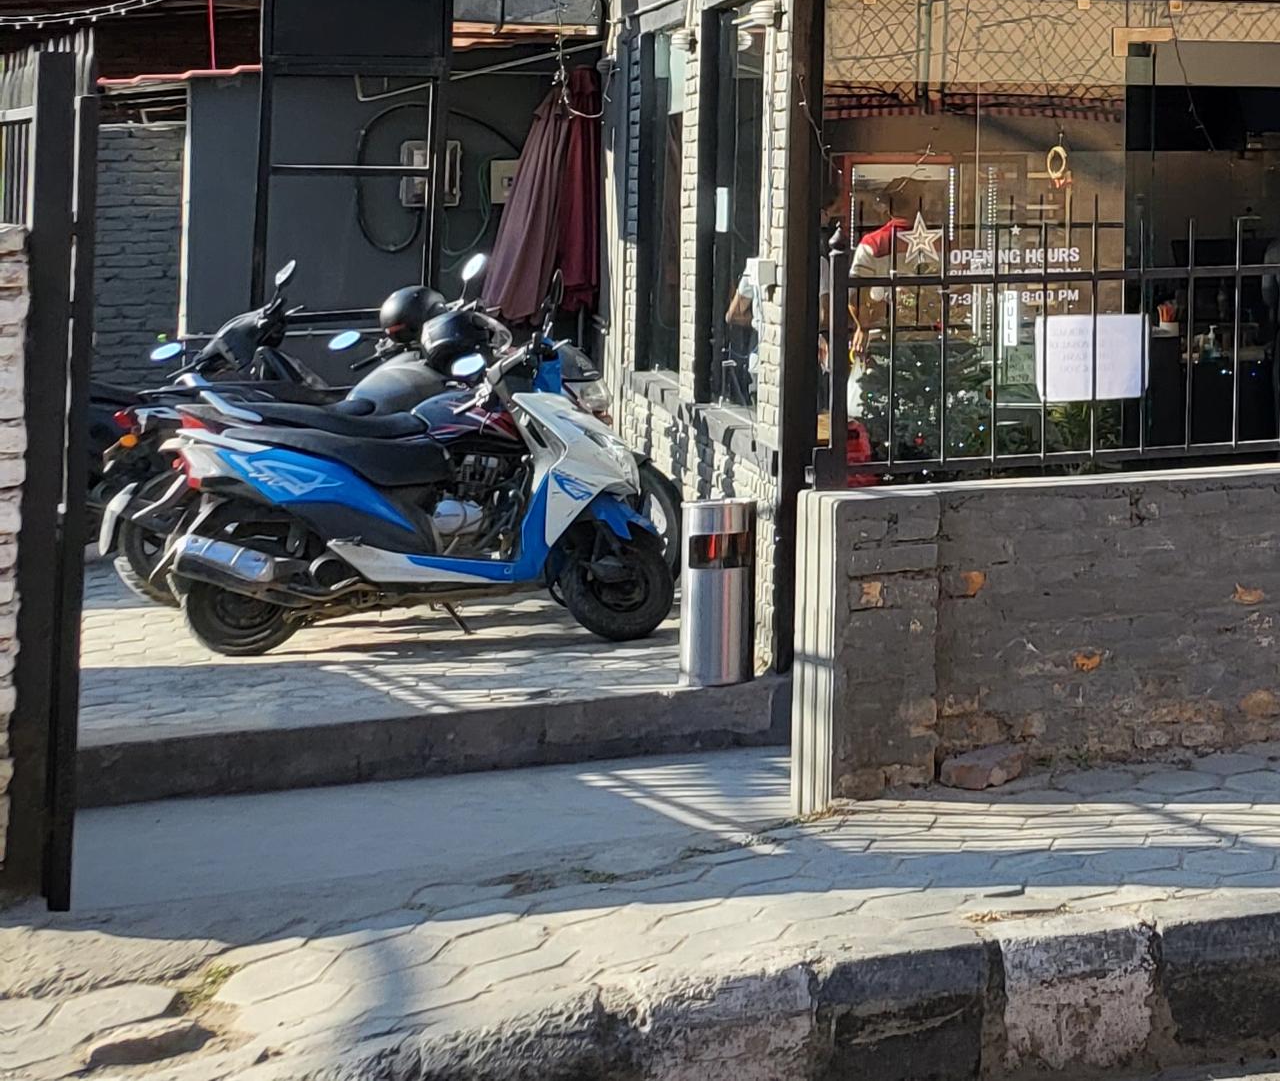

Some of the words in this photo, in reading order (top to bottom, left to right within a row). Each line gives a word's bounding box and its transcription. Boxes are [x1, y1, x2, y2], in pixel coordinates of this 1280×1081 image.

[1025, 247, 1080, 263] HOURS
[1021, 291, 1054, 303] 8:00
[1058, 289, 1079, 302] PM
